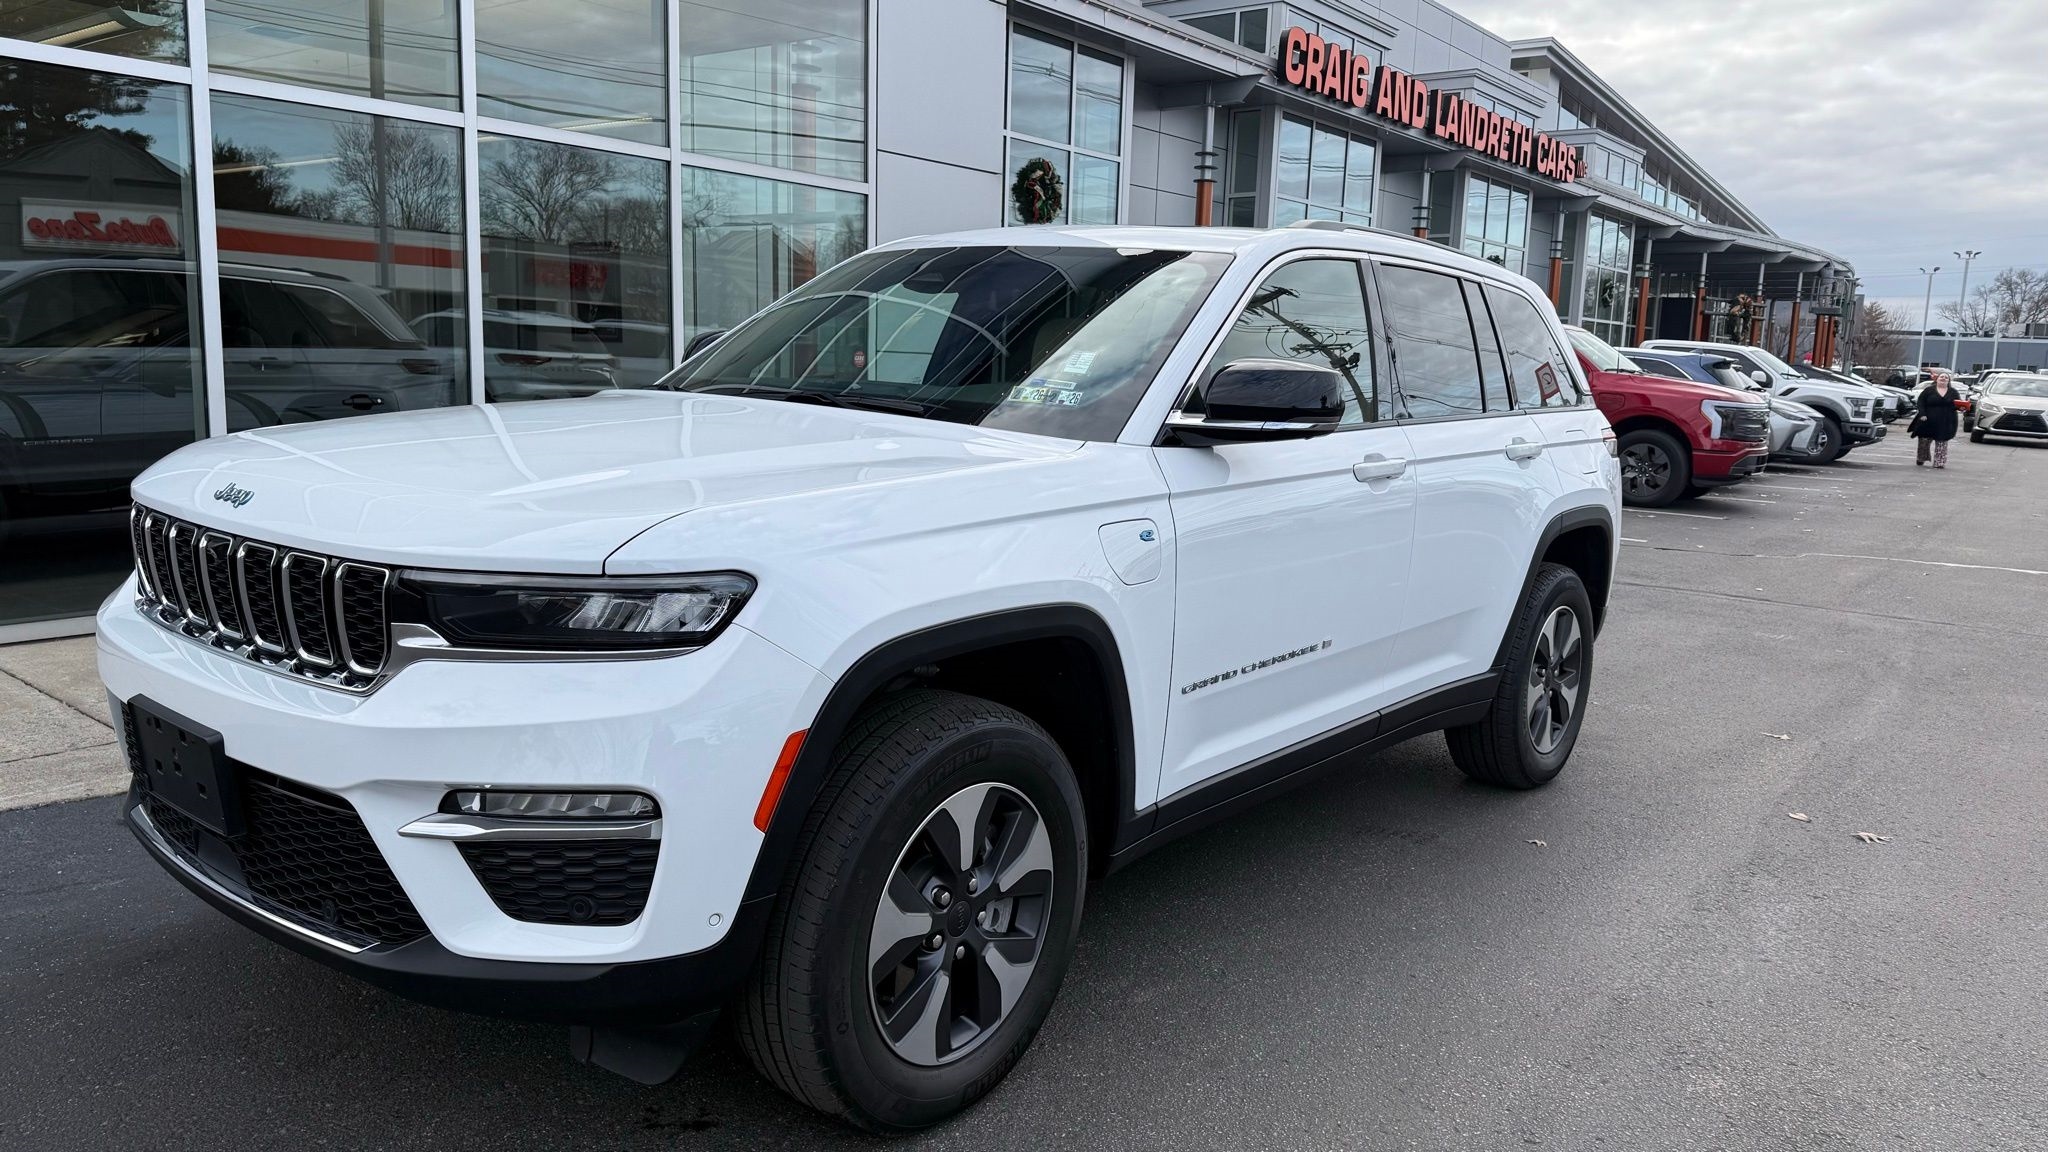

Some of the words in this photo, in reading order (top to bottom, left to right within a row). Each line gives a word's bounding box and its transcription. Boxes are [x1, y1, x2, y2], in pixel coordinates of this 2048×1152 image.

[1284, 26, 1370, 108] CRAIG
[1375, 65, 1428, 129] AND
[1434, 89, 1533, 168] LANDRETH
[1537, 133, 1577, 183] CARS
[213, 481, 255, 508] Jeep
[1181, 669, 1239, 695] GRAND
[1241, 643, 1320, 675] CHEROKEE
